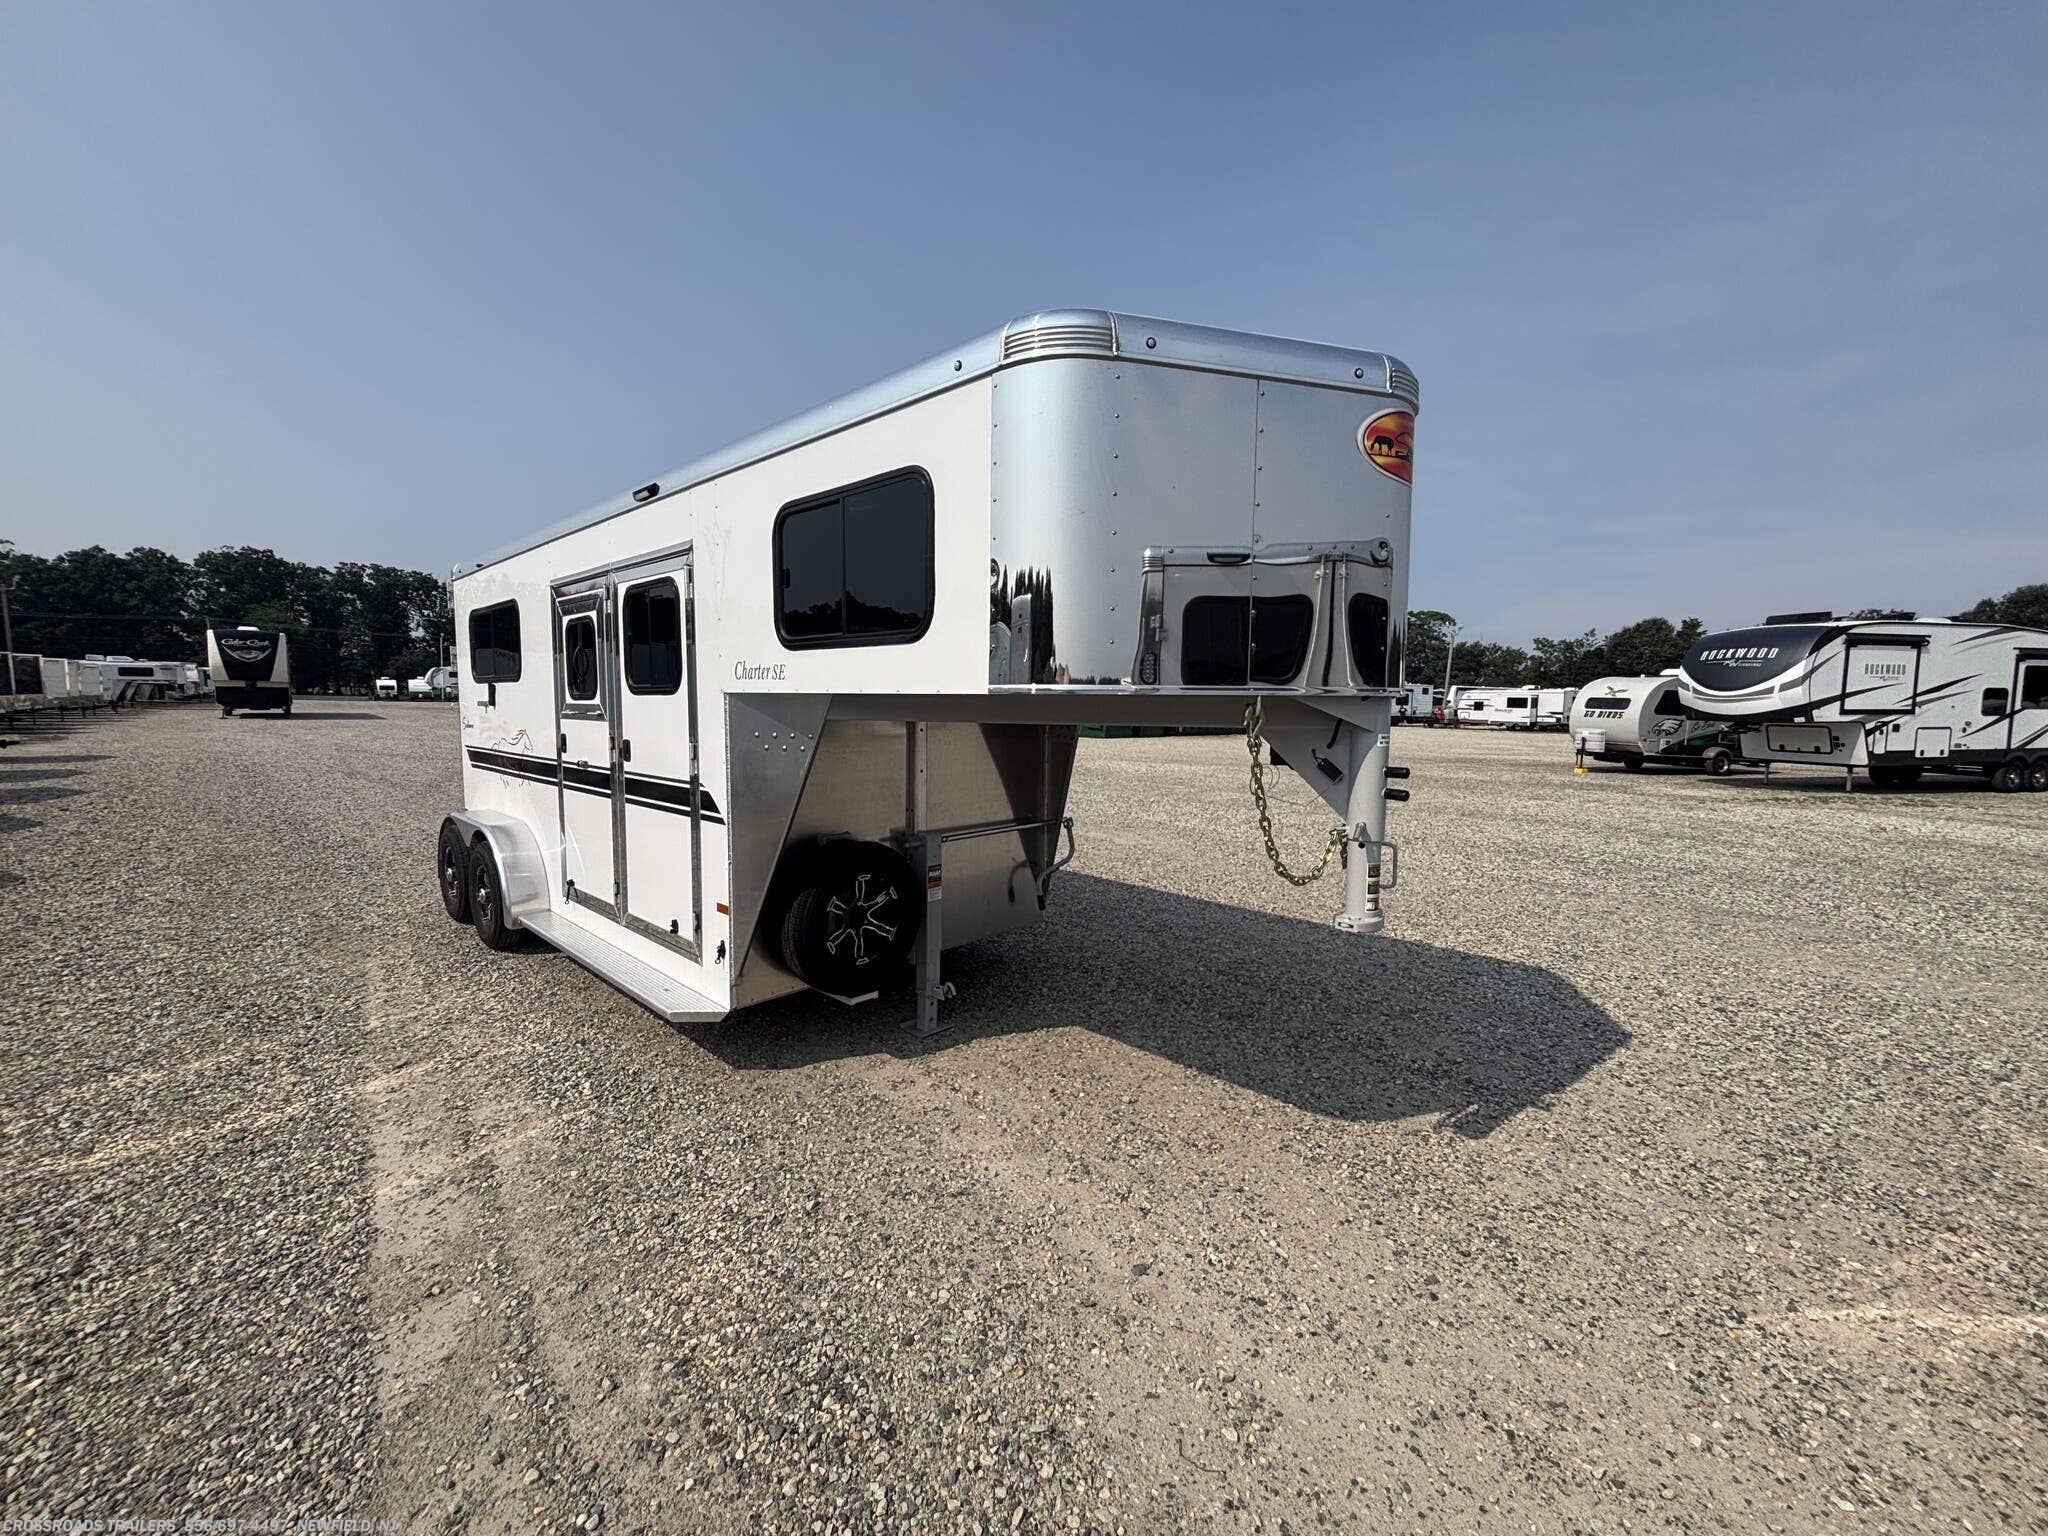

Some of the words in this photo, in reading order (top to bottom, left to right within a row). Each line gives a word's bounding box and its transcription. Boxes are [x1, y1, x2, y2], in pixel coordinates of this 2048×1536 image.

[1700, 648, 1779, 660] ROCKWOOD
[735, 660, 770, 680] Charter
[772, 664, 786, 680] SE
[1597, 711, 1625, 719] BIRDS
